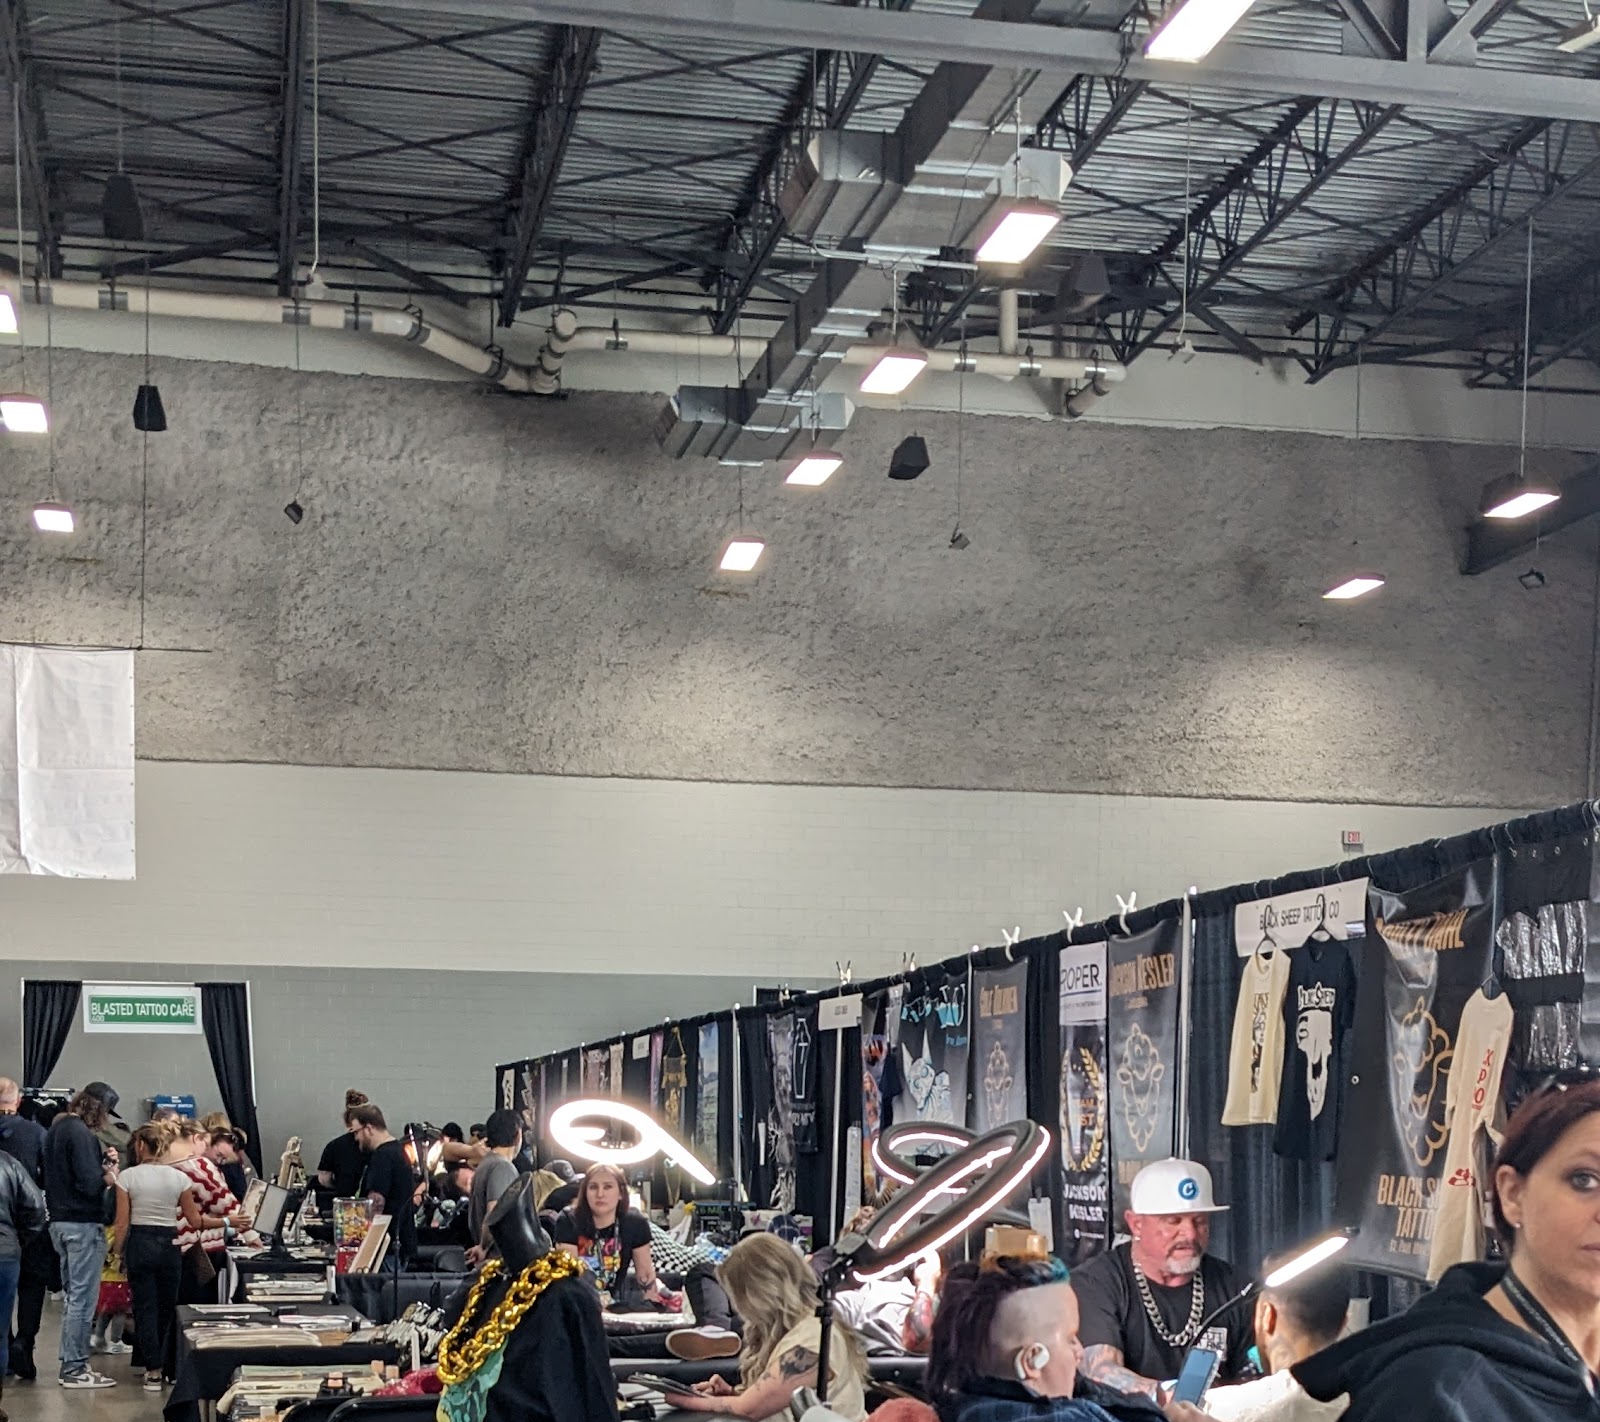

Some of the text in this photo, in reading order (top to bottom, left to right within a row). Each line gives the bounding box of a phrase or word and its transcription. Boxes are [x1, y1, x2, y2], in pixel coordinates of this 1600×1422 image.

[1347, 831, 1361, 843] EXIT
[1281, 907, 1301, 927] SHEEP
[1303, 902, 1326, 923] TATTO
[91, 1002, 195, 1017] BLASTED TATTOO CARE
[1062, 1183, 1106, 1201] JACKSON
[1377, 1174, 1424, 1208] BLACK
[1396, 1207, 1435, 1240] TATTO
